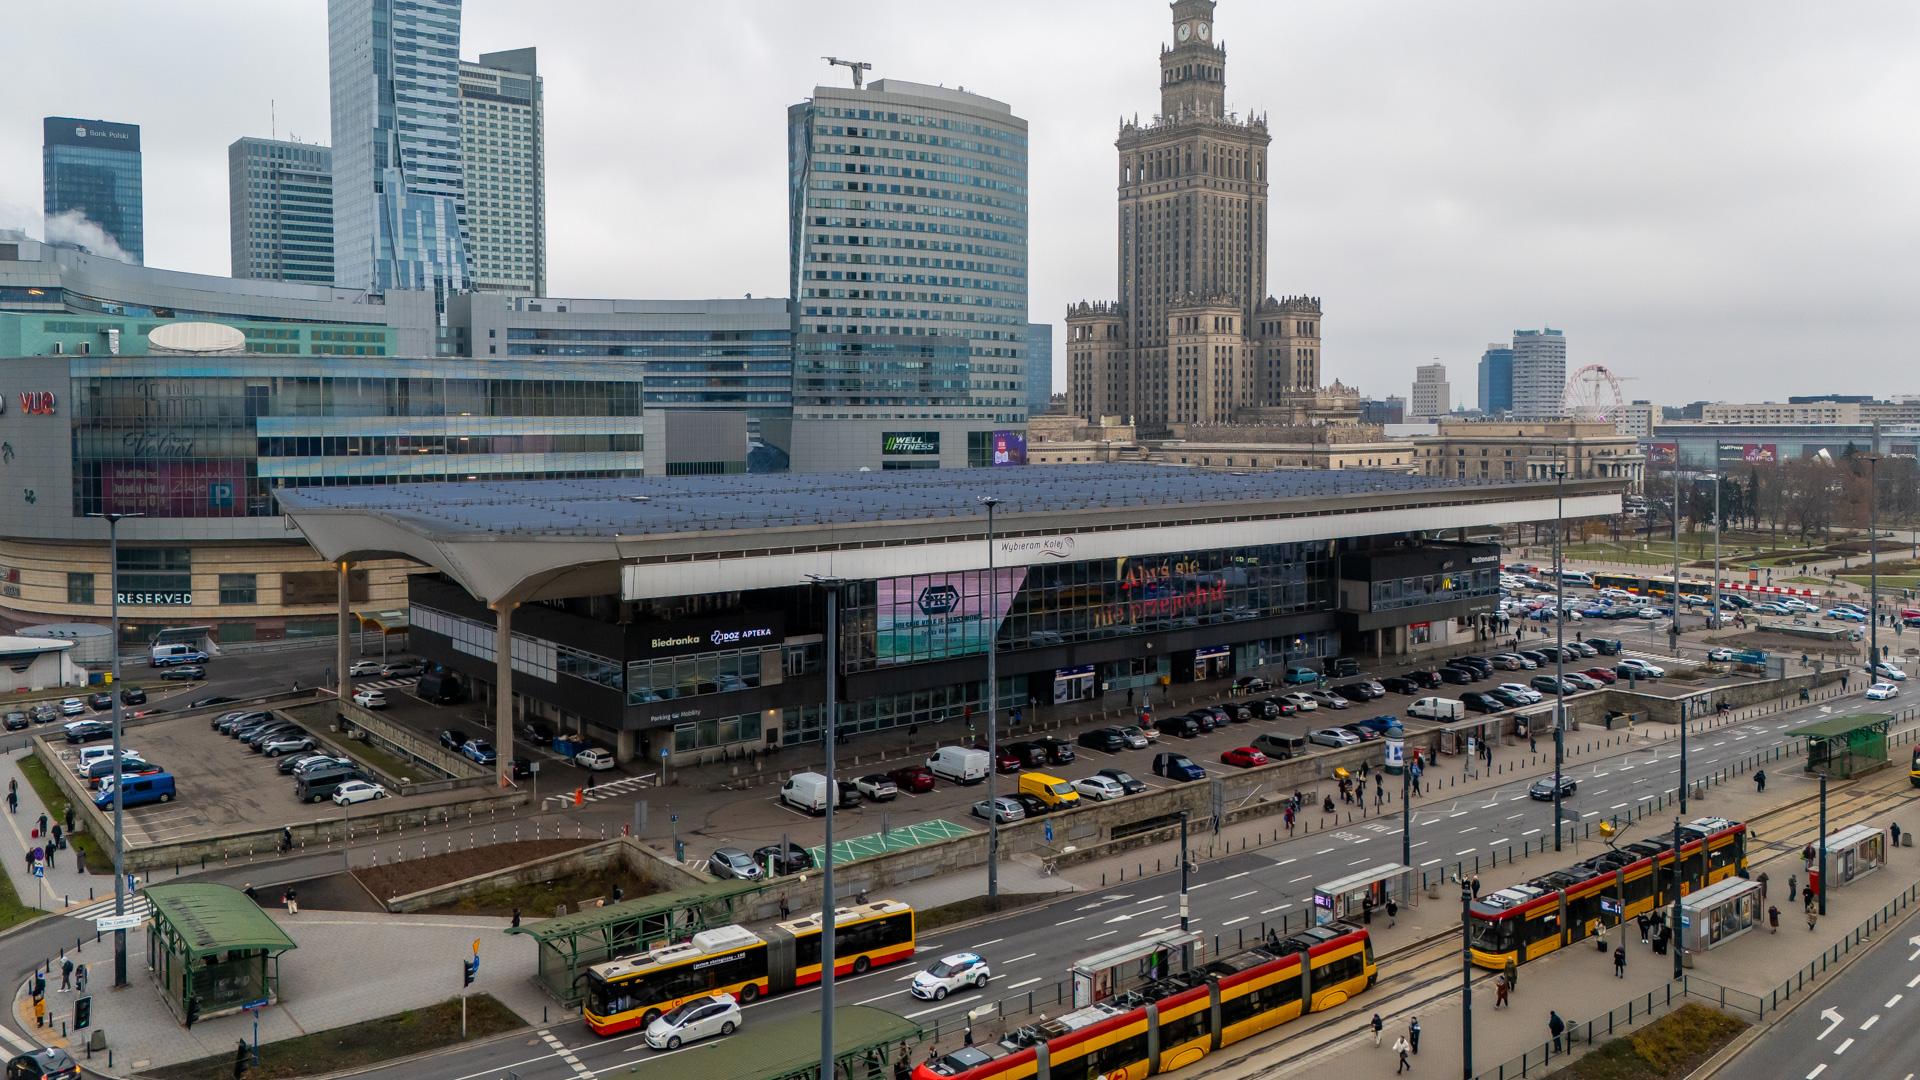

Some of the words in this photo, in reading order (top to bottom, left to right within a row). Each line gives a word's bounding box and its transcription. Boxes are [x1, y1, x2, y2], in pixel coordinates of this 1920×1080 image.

[89, 129, 107, 138] Bank
[109, 131, 129, 140] Polski
[896, 436, 924, 444] WELL
[1001, 541, 1041, 553] Wybieram
[1043, 540, 1064, 550] Kolej
[117, 593, 193, 604] RESERVED
[924, 593, 955, 607] PKP
[724, 631, 740, 640] DOZ
[742, 628, 772, 638] APTEKA
[651, 635, 700, 649] Biedronka
